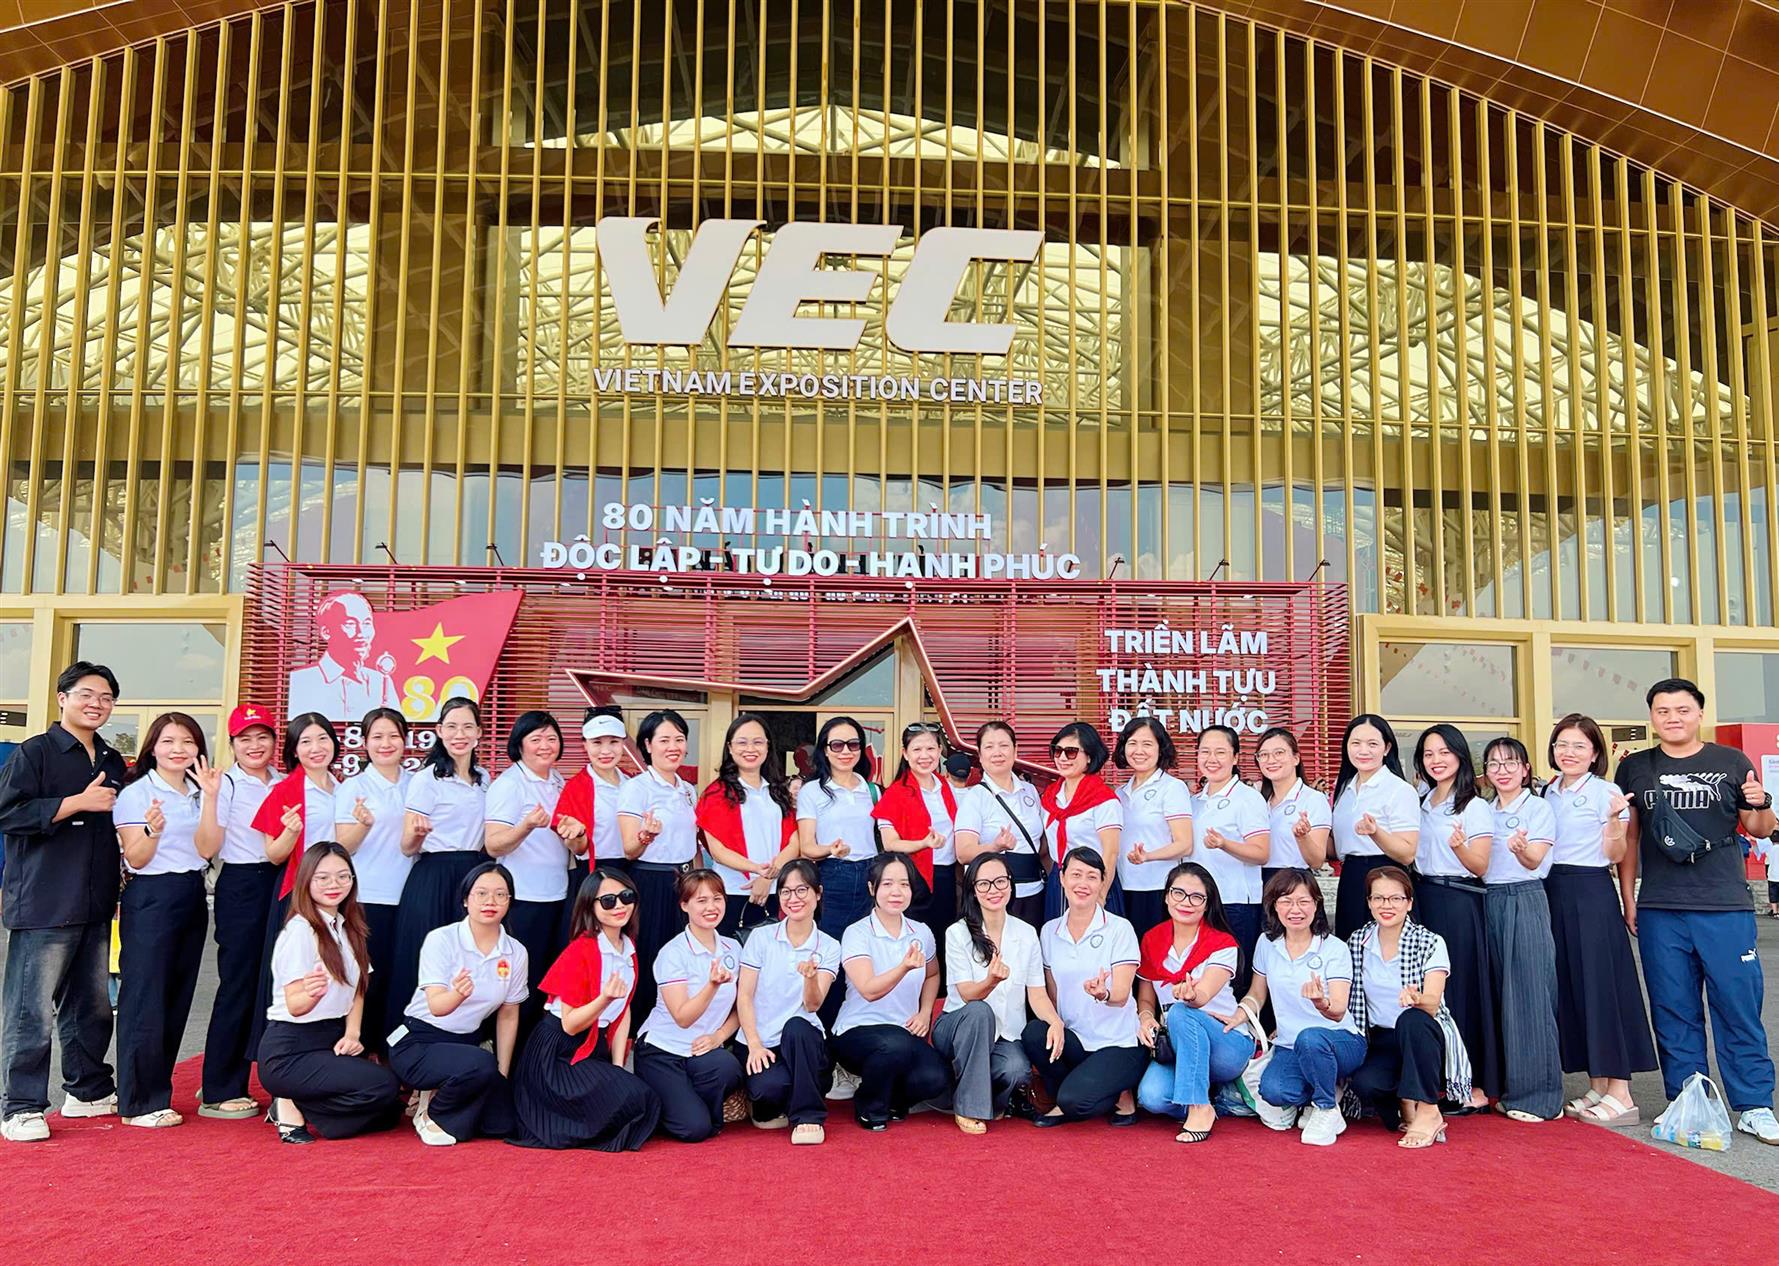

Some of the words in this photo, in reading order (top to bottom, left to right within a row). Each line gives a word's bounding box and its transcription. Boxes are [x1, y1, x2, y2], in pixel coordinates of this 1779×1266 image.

[595, 217, 1045, 355] VEC
[593, 368, 731, 395] VIETNAM
[739, 371, 920, 400] EXPOSITION
[930, 377, 1044, 404] CENTER
[602, 502, 653, 530] 80
[665, 497, 754, 534] NĂM
[766, 498, 873, 538] HÀNH
[882, 502, 992, 540] TRÌNH
[540, 534, 622, 580] ĐỘC
[630, 537, 701, 583] LẬP
[732, 546, 783, 586] TỰ
[788, 550, 839, 576] DO
[870, 551, 976, 589] HẠNH
[984, 543, 1081, 580] PHÚC
[1105, 619, 1194, 654] TRIỂN
[1200, 624, 1268, 655] LÃM
[1096, 663, 1207, 693] THÀNH
[1213, 667, 1276, 702] TỰU
